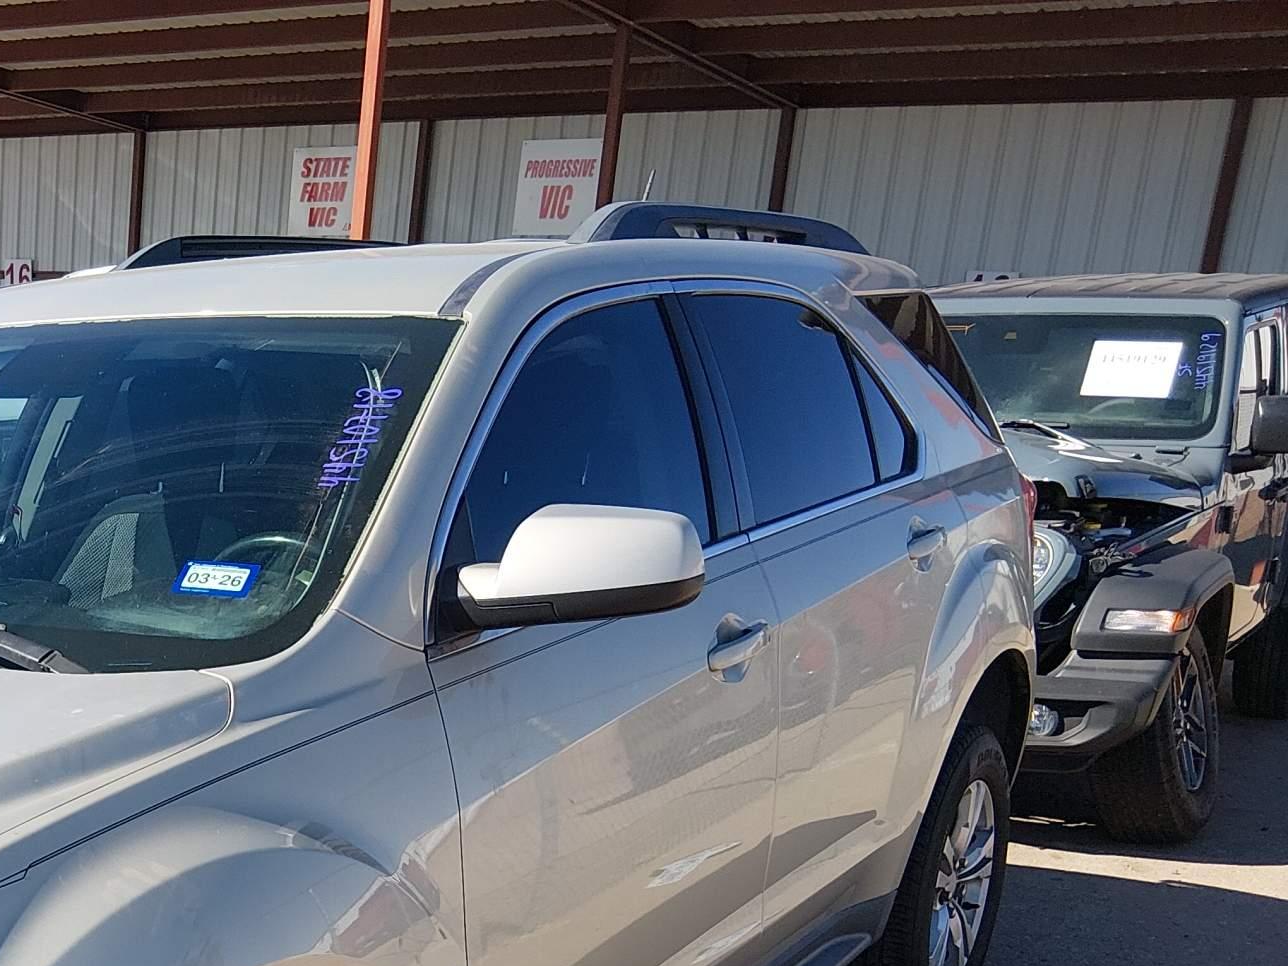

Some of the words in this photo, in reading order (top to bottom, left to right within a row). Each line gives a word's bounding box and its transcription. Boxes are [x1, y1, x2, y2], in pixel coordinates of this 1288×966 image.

[300, 156, 352, 179] STATE
[524, 158, 598, 179] PROGRESSIVE
[300, 181, 347, 203] FARM
[538, 184, 573, 220] VIC
[307, 206, 338, 228] VIC
[6, 262, 30, 285] 16
[1194, 333, 1222, 390] 44519129
[317, 387, 403, 488] 44510718
